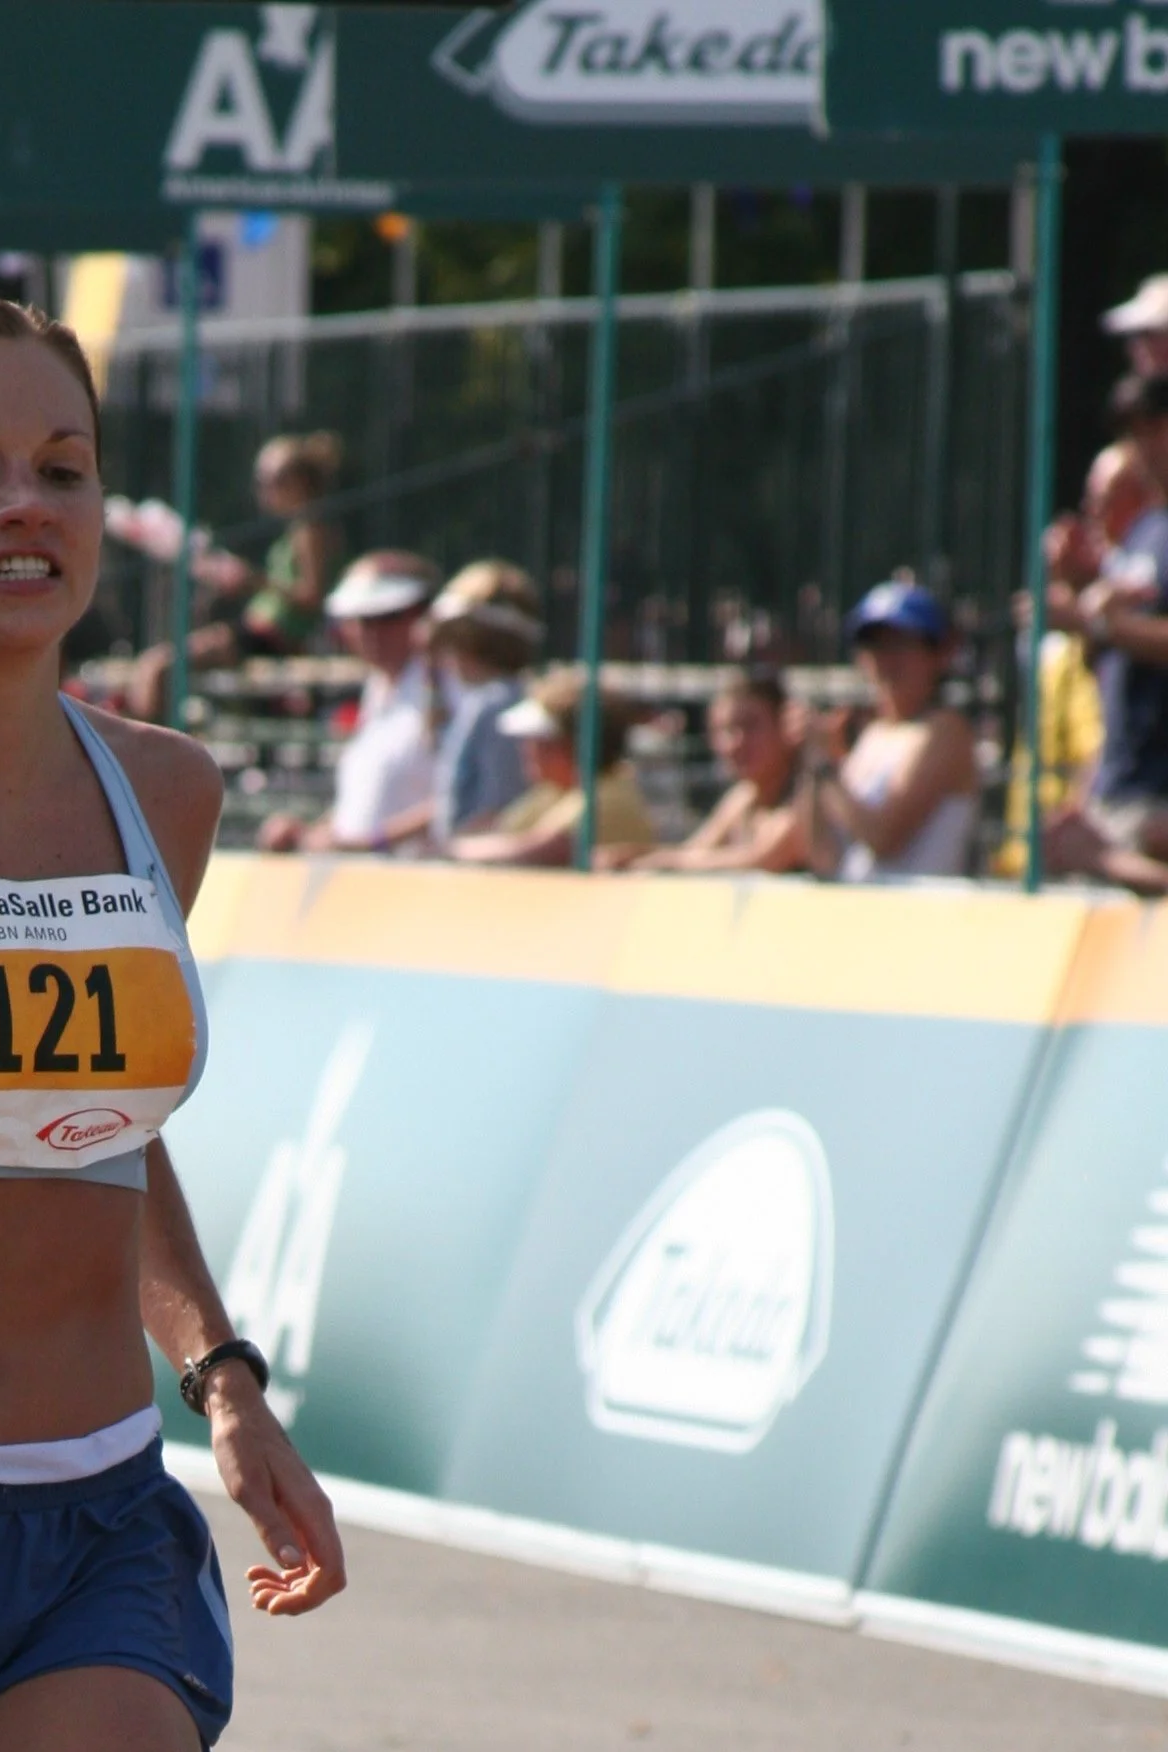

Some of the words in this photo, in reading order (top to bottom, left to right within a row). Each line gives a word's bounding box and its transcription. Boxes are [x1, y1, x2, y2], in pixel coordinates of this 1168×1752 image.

[938, 30, 1119, 93] new
[80, 888, 148, 916] Bank
[24, 925, 68, 942] AMRO
[985, 1428, 1094, 1540] new
